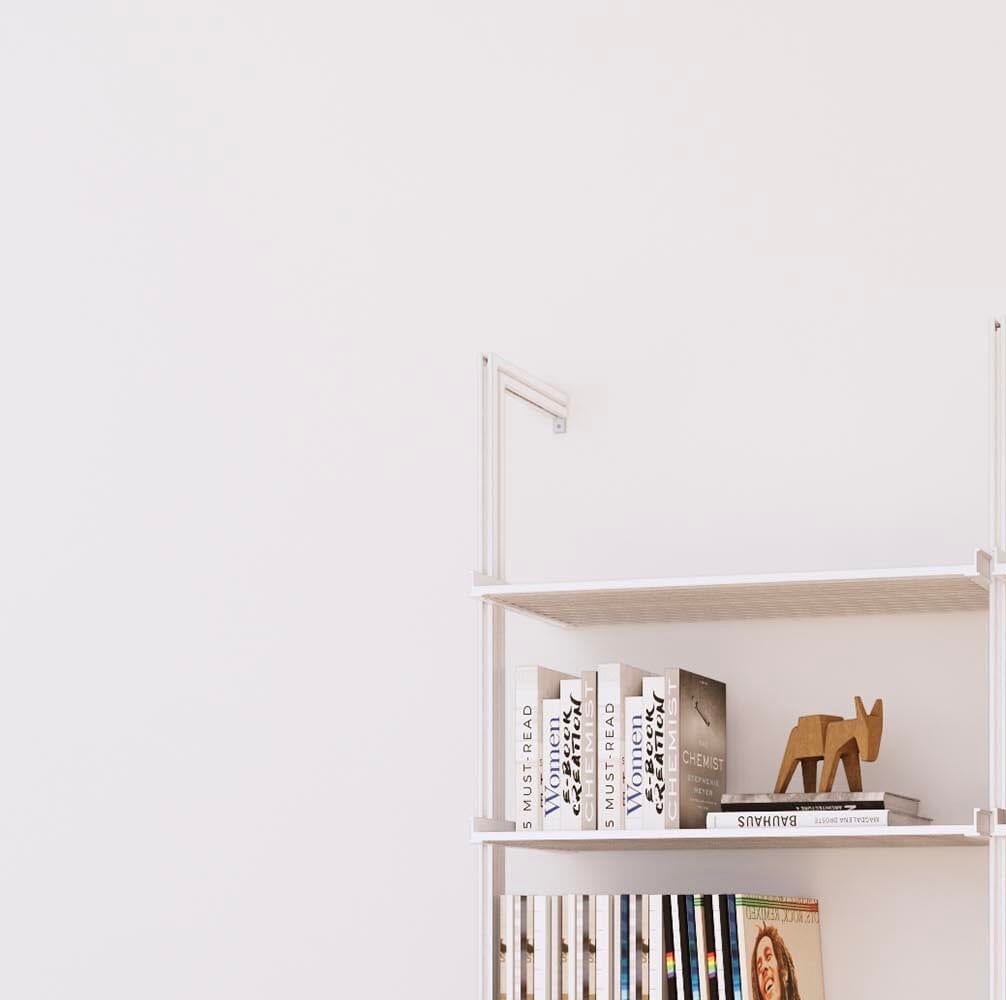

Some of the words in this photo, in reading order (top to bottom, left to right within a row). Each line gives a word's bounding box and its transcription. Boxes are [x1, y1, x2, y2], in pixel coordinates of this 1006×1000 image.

[523, 705, 532, 811] MUST-READ
[544, 717, 560, 816] Women
[563, 706, 572, 804] E-BOOK
[570, 692, 582, 816] CREATION
[585, 681, 593, 822] CHEMIST
[605, 703, 614, 810] MUST-READ
[627, 715, 642, 815] Women
[645, 704, 655, 802] E-BOOK
[653, 690, 665, 815] CREATION
[668, 678, 677, 821] CHEMIST
[682, 750, 724, 771] CHEMIST
[523, 821, 532, 829] 5
[605, 820, 614, 828] 5
[738, 815, 797, 828] BAUHAUS
